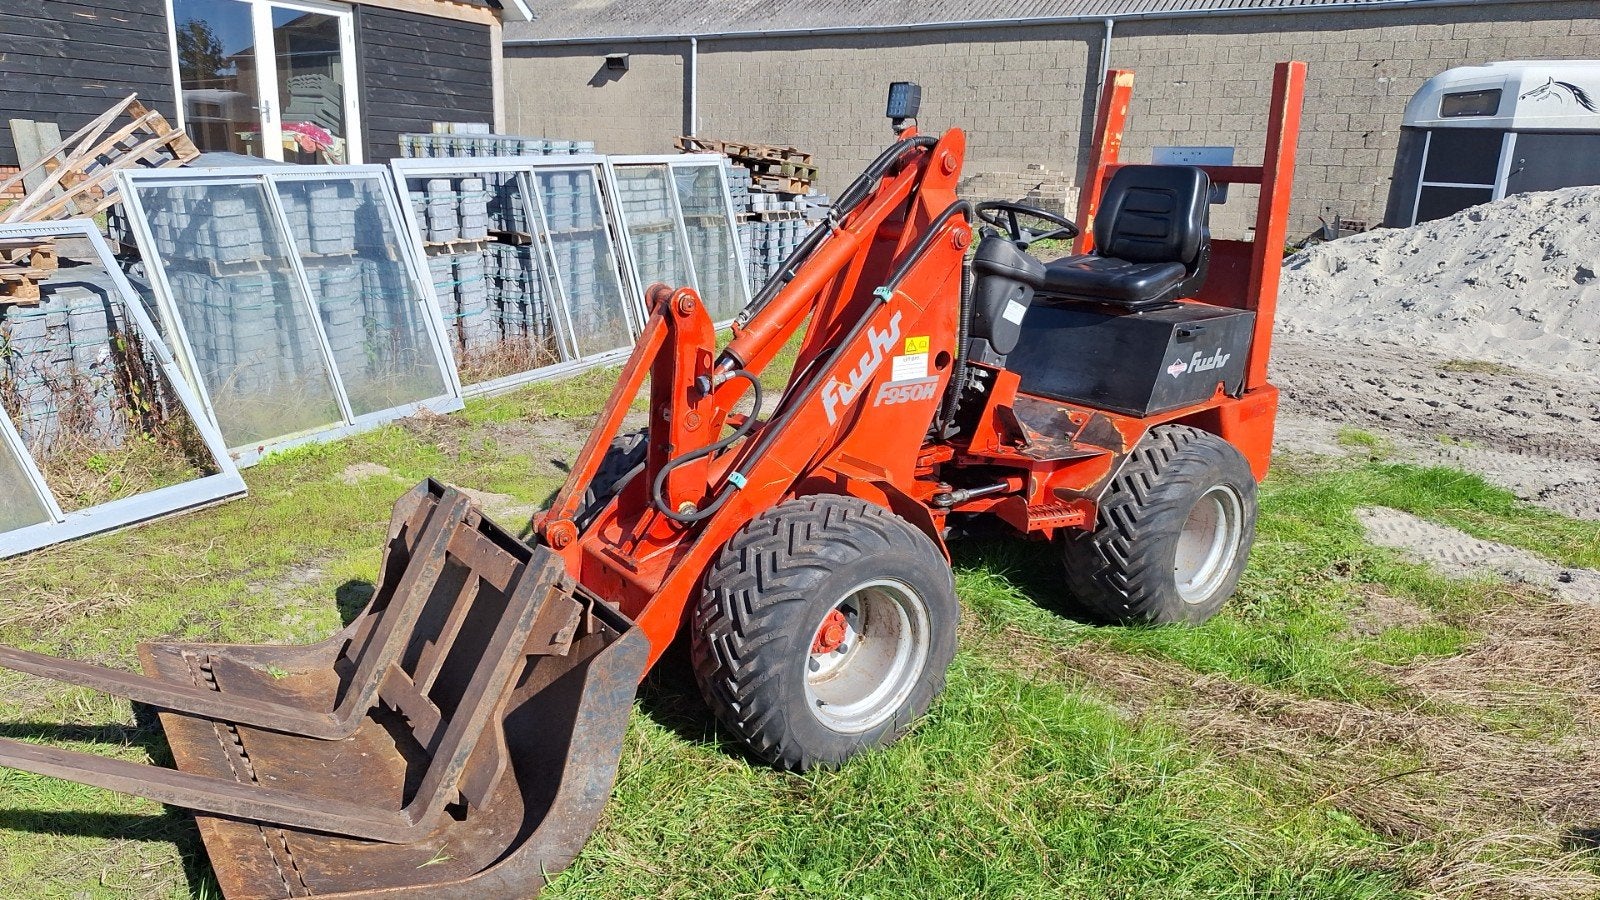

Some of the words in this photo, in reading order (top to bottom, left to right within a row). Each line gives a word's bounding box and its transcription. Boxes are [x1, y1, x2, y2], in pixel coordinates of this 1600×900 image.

[821, 309, 902, 426] Fuchs
[1186, 347, 1231, 374] Fuchs
[873, 375, 940, 408] F950H
